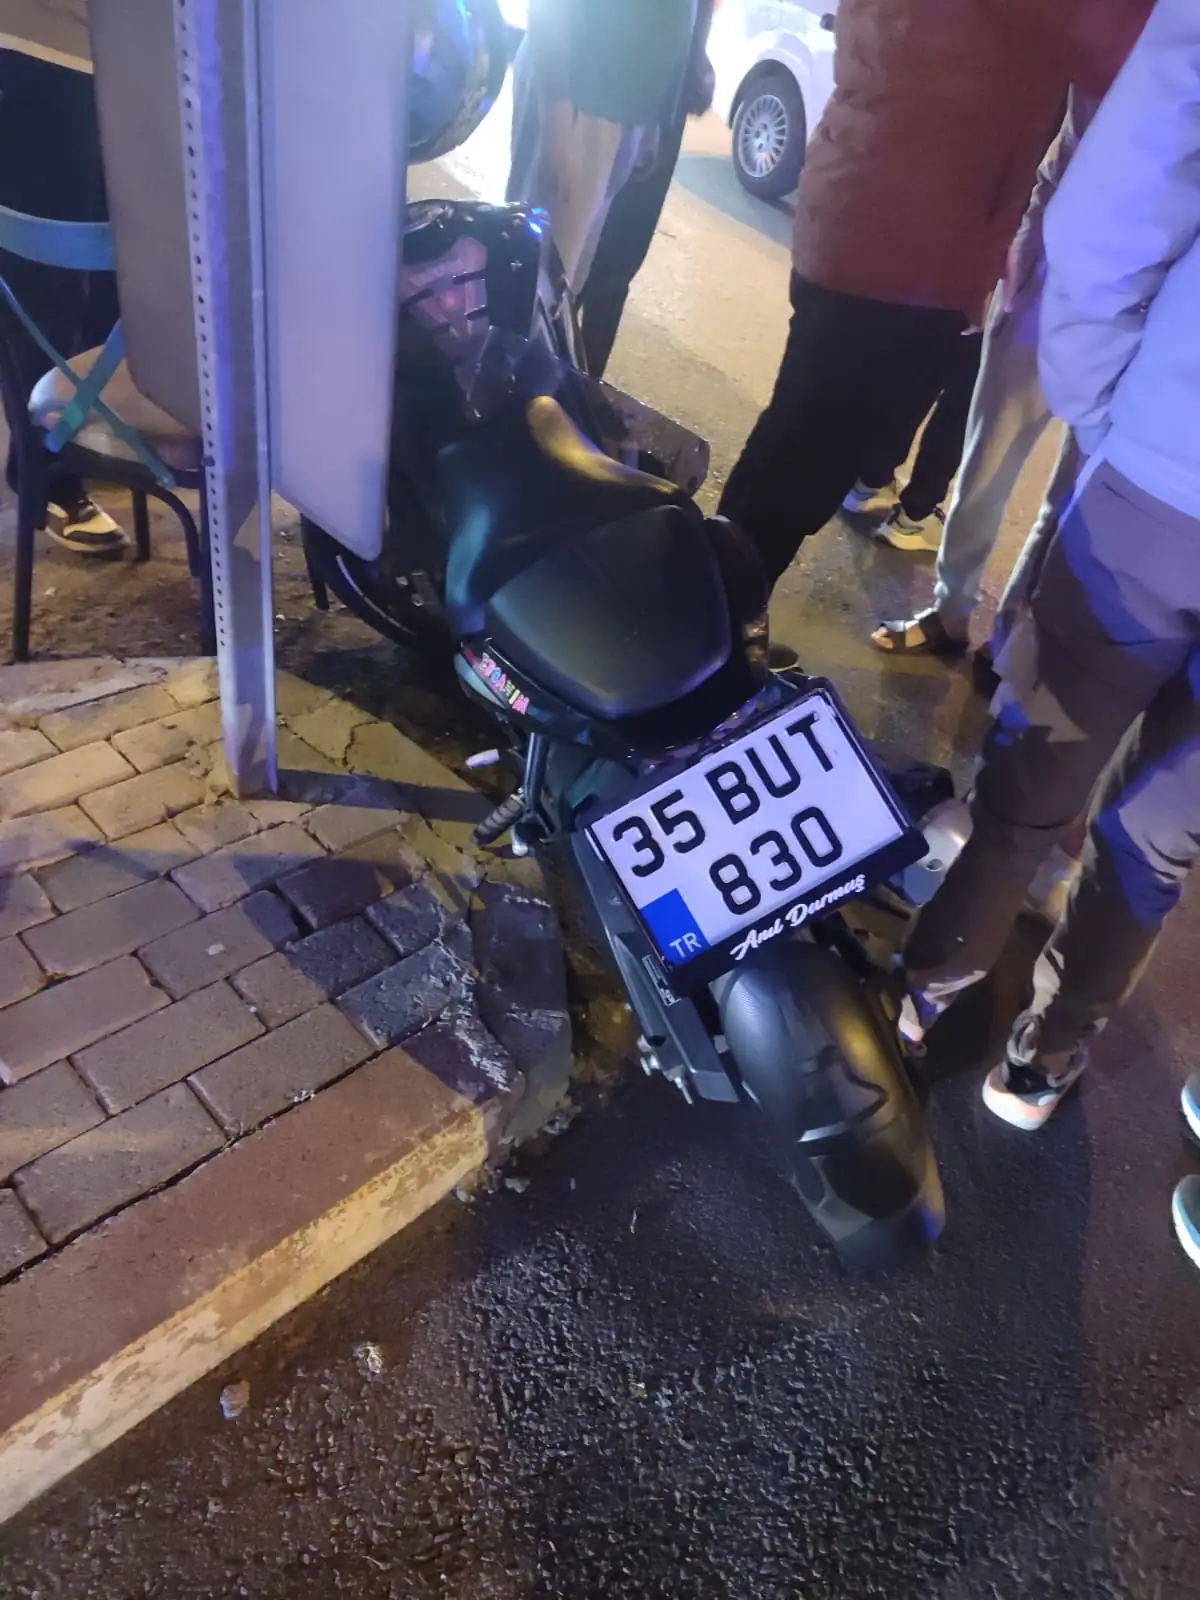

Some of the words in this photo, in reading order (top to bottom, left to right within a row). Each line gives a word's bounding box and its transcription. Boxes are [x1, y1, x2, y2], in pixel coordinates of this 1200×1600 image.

[612, 789, 706, 878] 35
[704, 711, 834, 825] BUT
[709, 807, 843, 915] 830
[669, 932, 702, 958] TR
